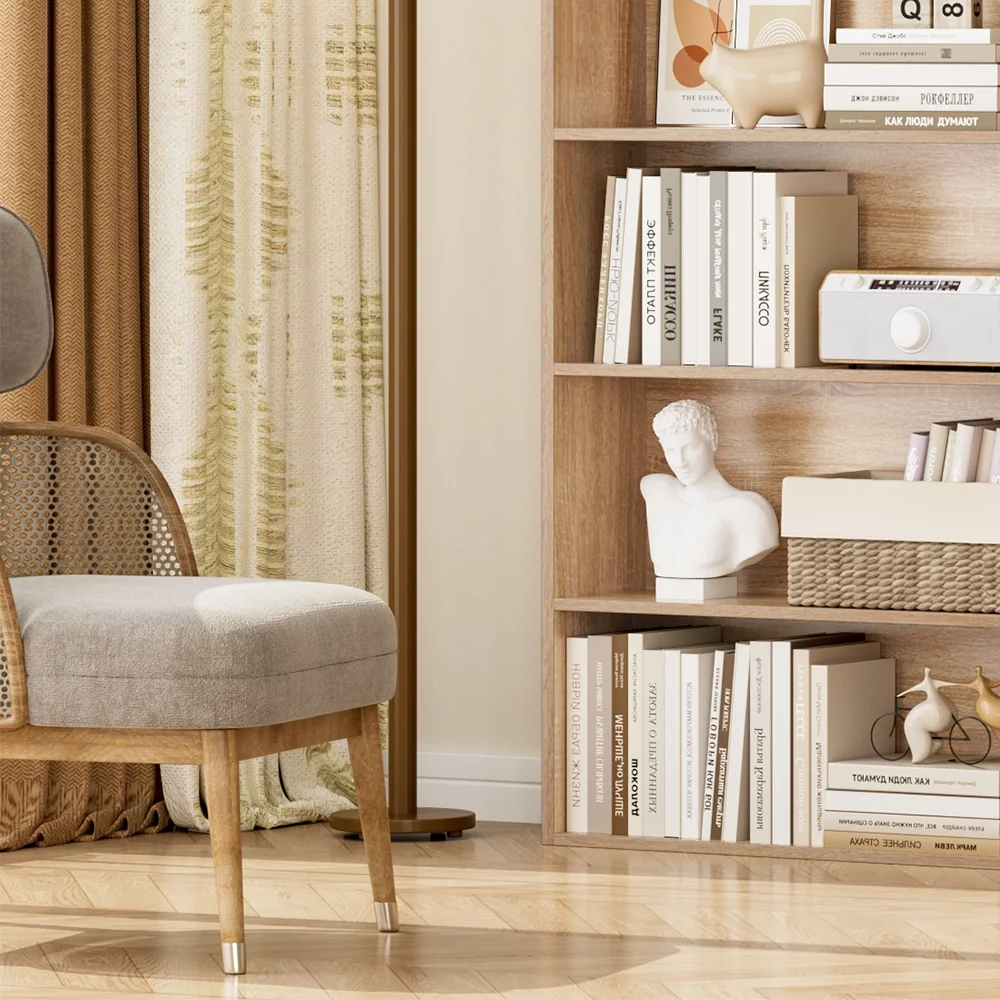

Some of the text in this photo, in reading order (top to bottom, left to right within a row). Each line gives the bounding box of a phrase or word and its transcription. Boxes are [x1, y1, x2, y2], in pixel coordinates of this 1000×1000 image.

[920, 93, 975, 105] РОКФЕЛЛЕР
[884, 117, 904, 126] КАК
[905, 116, 934, 127] ЛЮДИ
[937, 116, 979, 127] ДУМАЮТ
